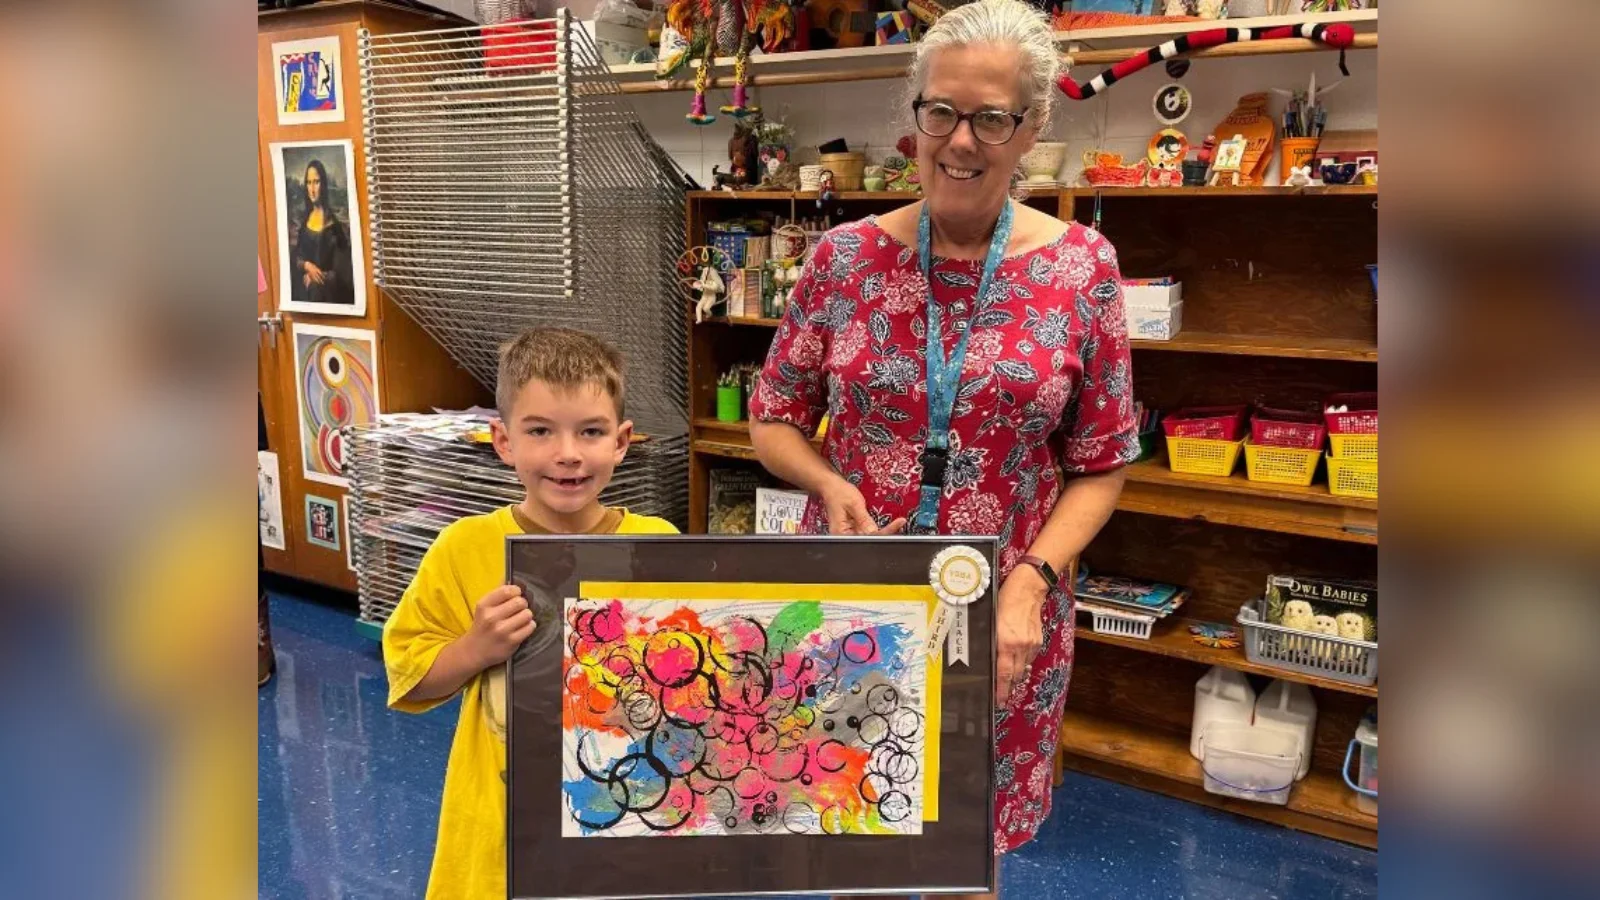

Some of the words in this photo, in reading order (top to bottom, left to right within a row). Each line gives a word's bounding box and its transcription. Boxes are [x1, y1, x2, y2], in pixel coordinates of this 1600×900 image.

[769, 503, 804, 521] LOVE
[1322, 584, 1369, 603] BABIES
[955, 611, 963, 655] PLACE
